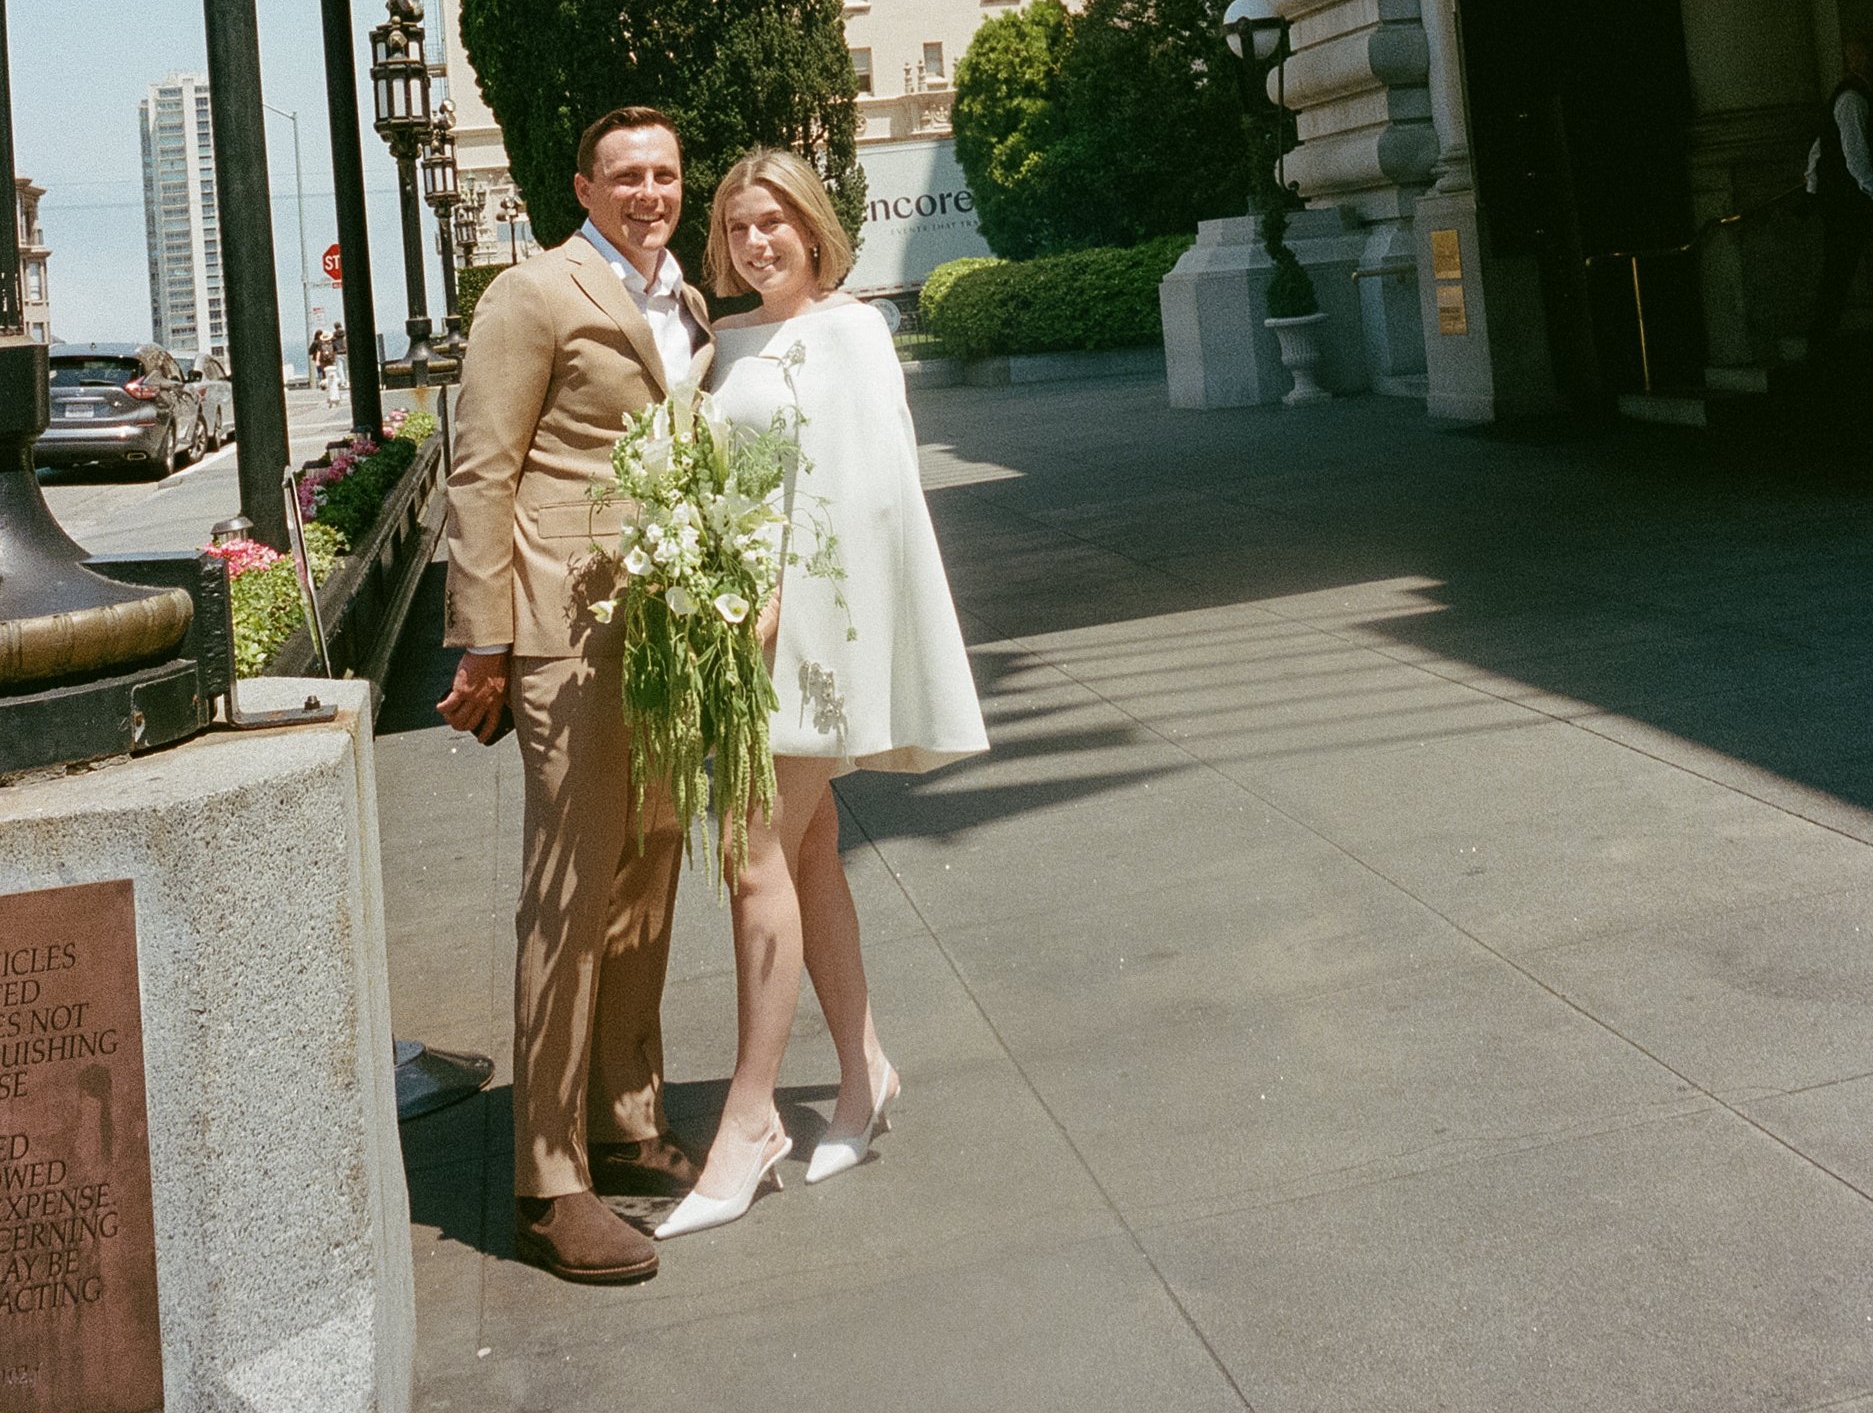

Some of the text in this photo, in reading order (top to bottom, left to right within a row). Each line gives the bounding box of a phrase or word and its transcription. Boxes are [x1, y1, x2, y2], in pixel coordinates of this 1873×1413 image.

[870, 190, 975, 222] ncore
[325, 254, 340, 270] ST
[0, 942, 77, 978] ICLES
[0, 979, 41, 1007] ED
[30, 1002, 90, 1035] NOT
[1, 1028, 119, 1068] UISHING
[0, 1070, 28, 1100] SE
[0, 1159, 66, 1191] WED
[0, 1183, 117, 1222] XPENSE.
[0, 1211, 119, 1254] CERNING
[0, 1248, 80, 1285] AY BE
[0, 1276, 102, 1315] ACTING
